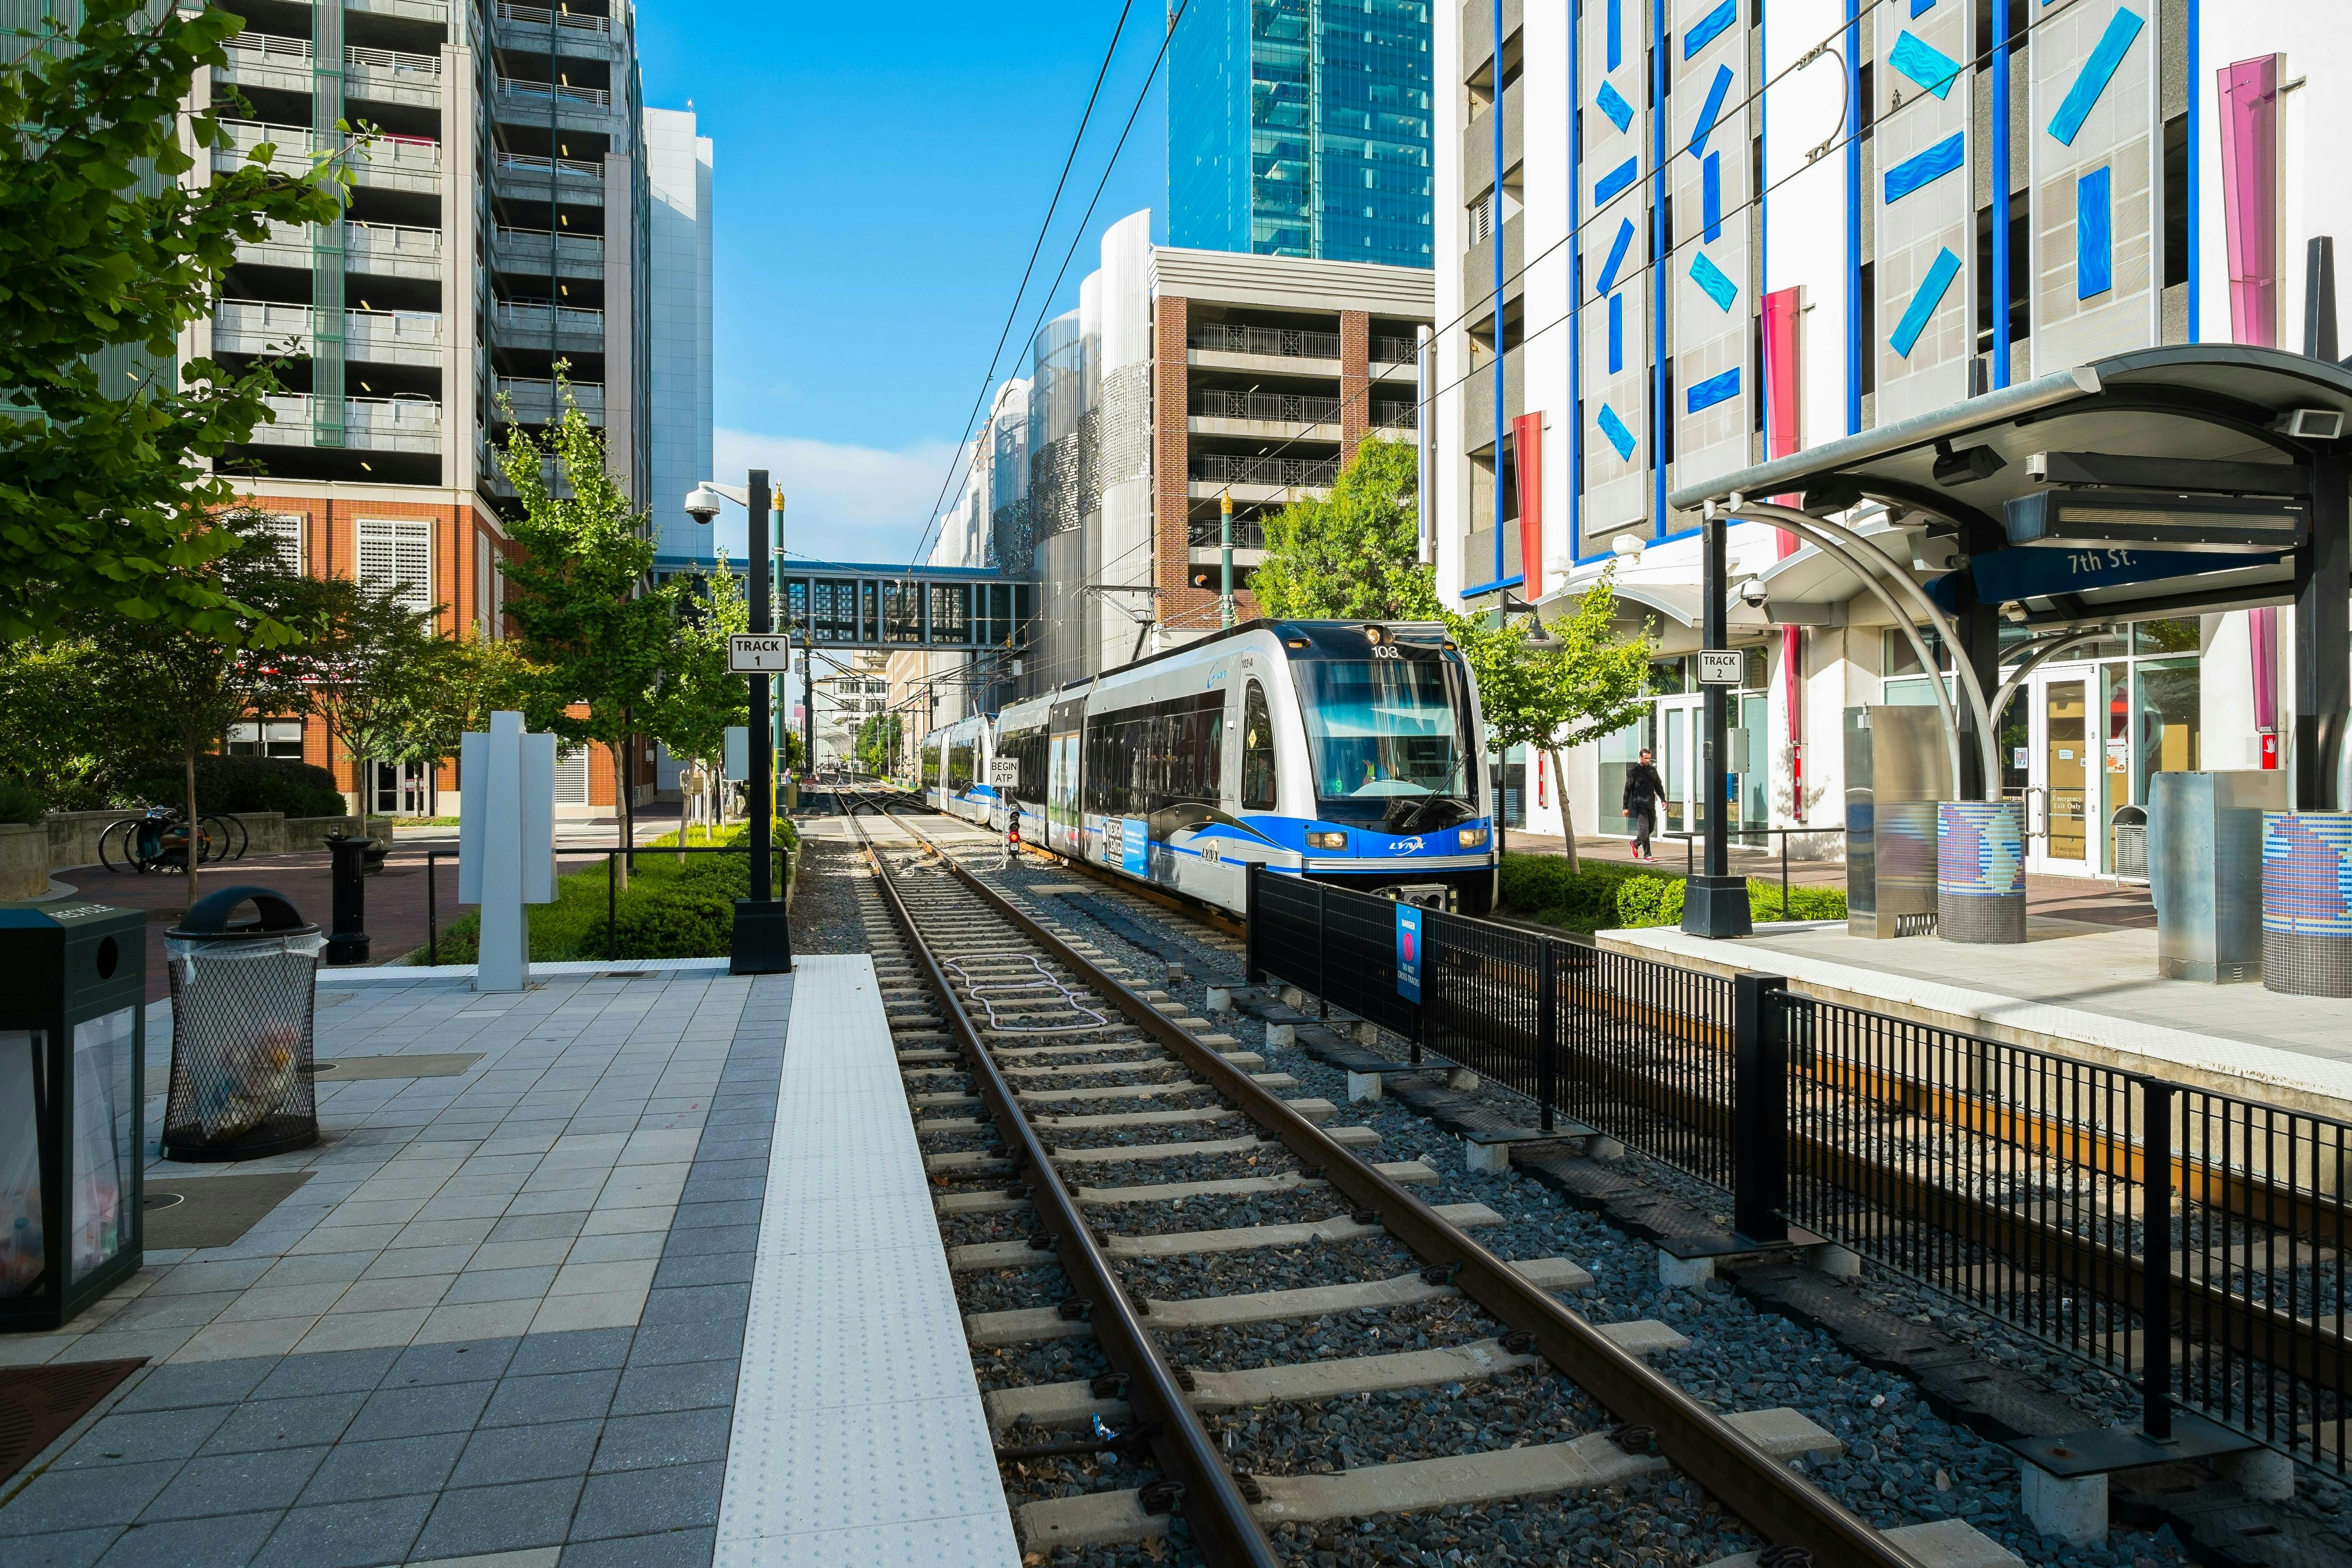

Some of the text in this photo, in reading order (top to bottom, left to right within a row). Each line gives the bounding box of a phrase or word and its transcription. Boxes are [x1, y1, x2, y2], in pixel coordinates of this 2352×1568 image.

[2068, 549, 2137, 574] 7th St.
[736, 641, 779, 651] TRACK
[1372, 646, 1398, 658] 103
[755, 656, 760, 666] 1
[1242, 658, 1253, 669] 103-A
[1704, 656, 1735, 665] TRACK
[1717, 669, 1722, 678] 2
[992, 762, 1017, 771] BEGIN
[995, 774, 1013, 783] ATP
[1109, 822, 1122, 838] DESIGN
[1109, 838, 1122, 855] CENTER
[1201, 848, 1219, 861] LYNX
[48, 905, 115, 919] RECYCLE
[1401, 919, 1415, 930] DANGER
[1402, 962, 1408, 971] DO
[1398, 971, 1419, 987] CROSS TRACKS
